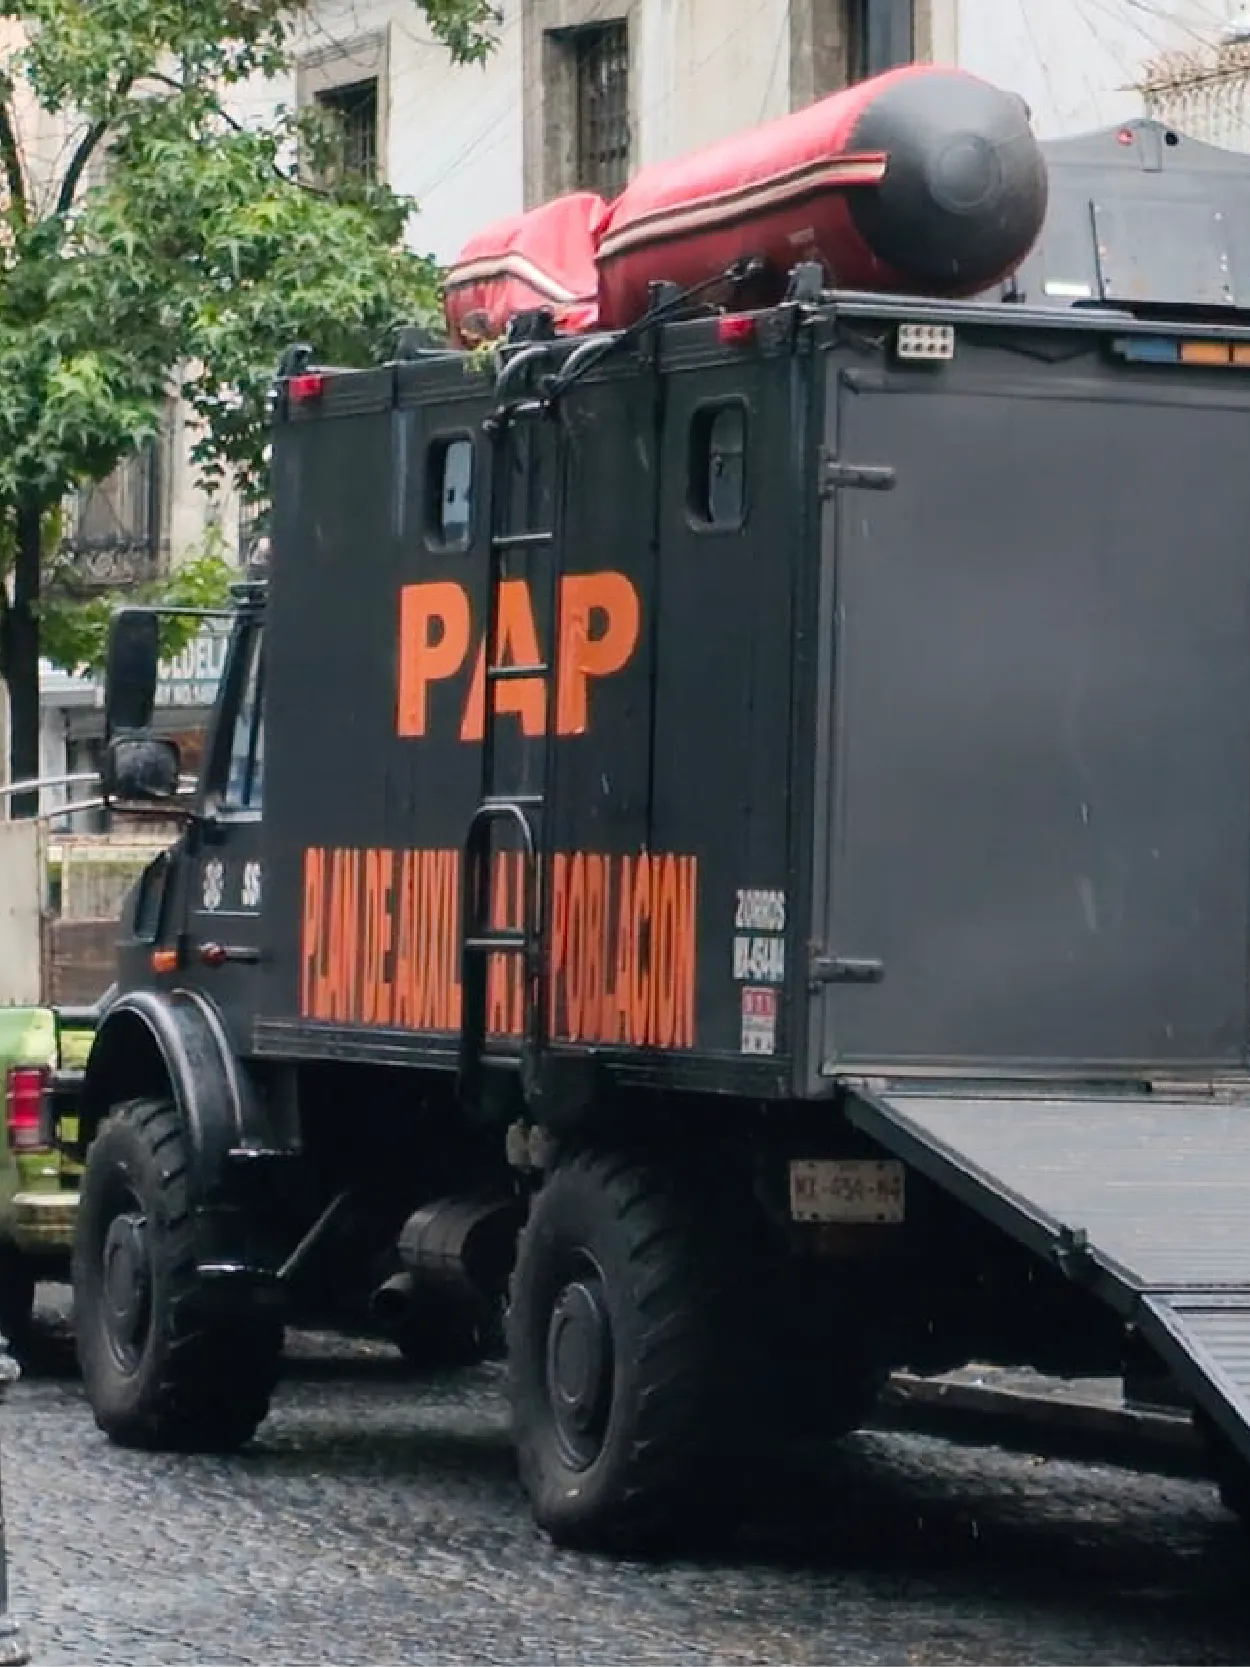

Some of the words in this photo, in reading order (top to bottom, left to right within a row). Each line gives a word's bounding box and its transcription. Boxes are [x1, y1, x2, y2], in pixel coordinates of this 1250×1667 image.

[397, 571, 640, 741] PAP
[301, 847, 358, 1022] PLAN
[362, 848, 394, 1026] DE
[394, 848, 464, 1030] AUXIL
[548, 851, 699, 1050] POBLACION
